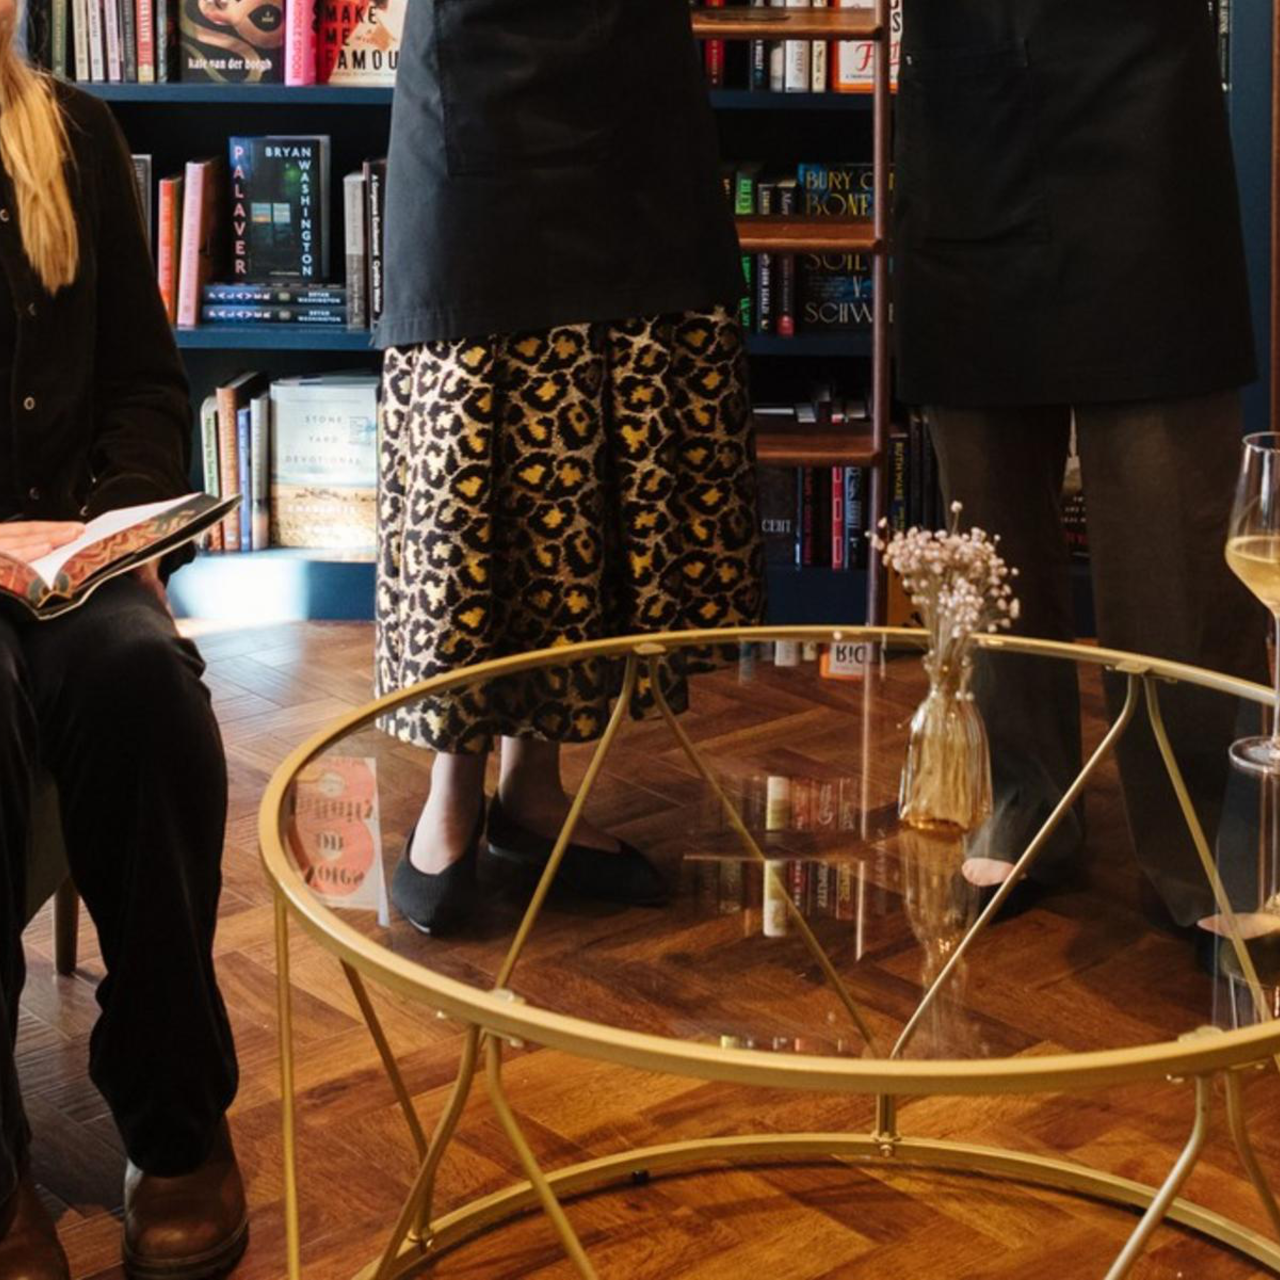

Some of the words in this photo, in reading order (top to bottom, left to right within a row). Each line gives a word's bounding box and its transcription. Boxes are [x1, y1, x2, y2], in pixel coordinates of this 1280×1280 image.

[325, 5, 377, 25] MAKE
[325, 31, 351, 46] ME
[292, 40, 302, 79] SPOON
[325, 51, 400, 70] FAMOU
[265, 147, 311, 158] BRYAN
[806, 171, 852, 190] BURY
[233, 146, 247, 274] PALAVER
[371, 182, 379, 215] Gorgeous
[298, 160, 313, 276] WASHINGTON
[372, 260, 380, 287] Cynthia
